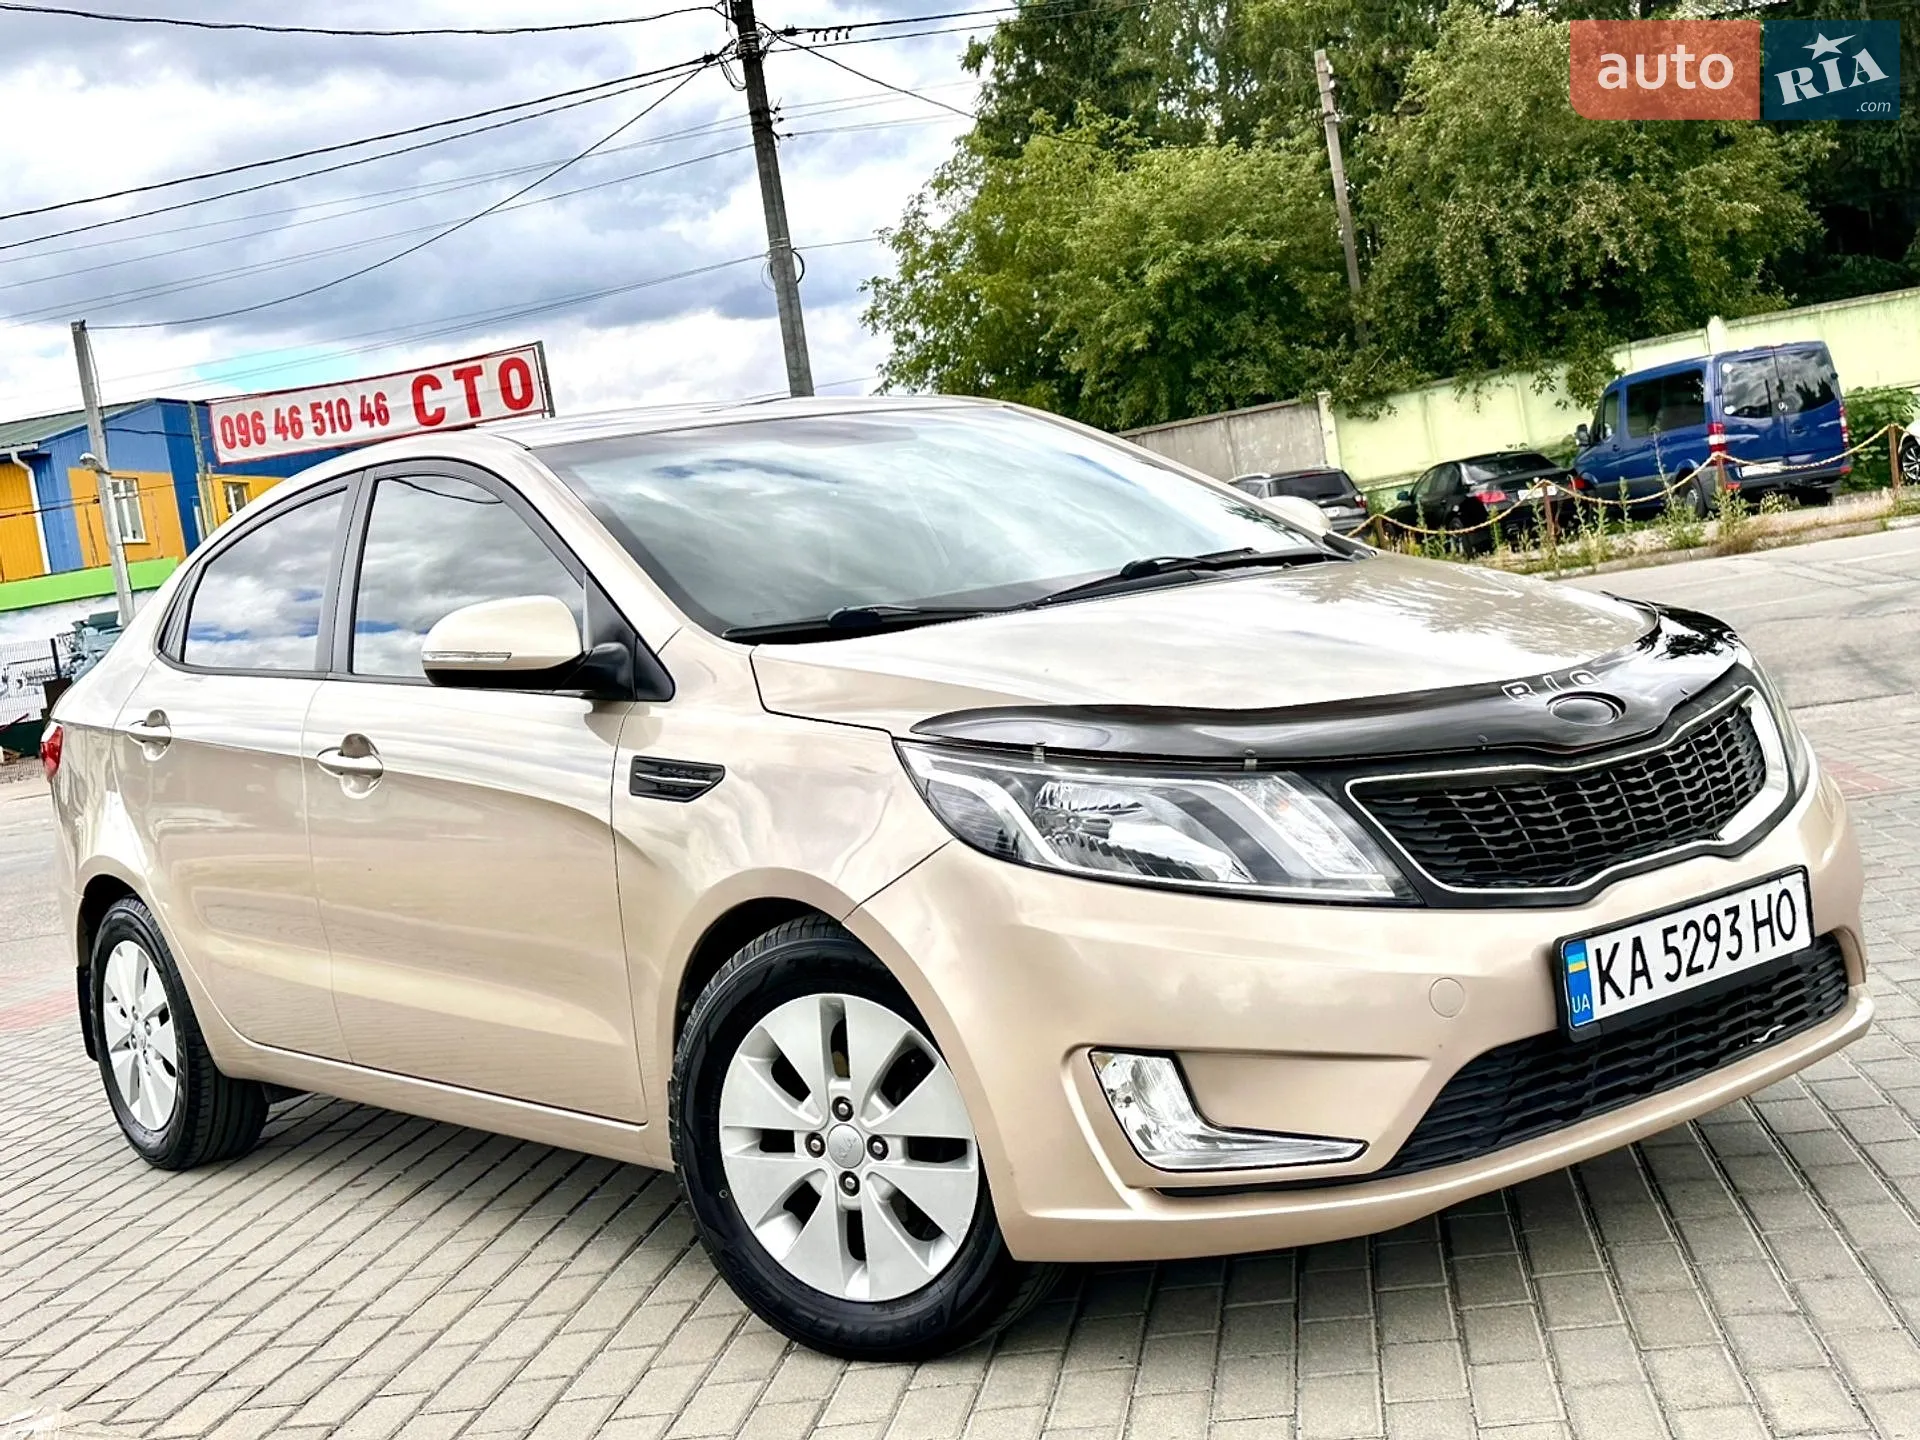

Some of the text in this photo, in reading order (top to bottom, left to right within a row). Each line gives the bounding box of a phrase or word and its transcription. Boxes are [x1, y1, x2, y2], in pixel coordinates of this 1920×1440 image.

[219, 356, 536, 450] 096 46 510 46 СТО
[1595, 887, 1797, 1006] KA 5293 HO
[1571, 993, 1591, 1014] UA
